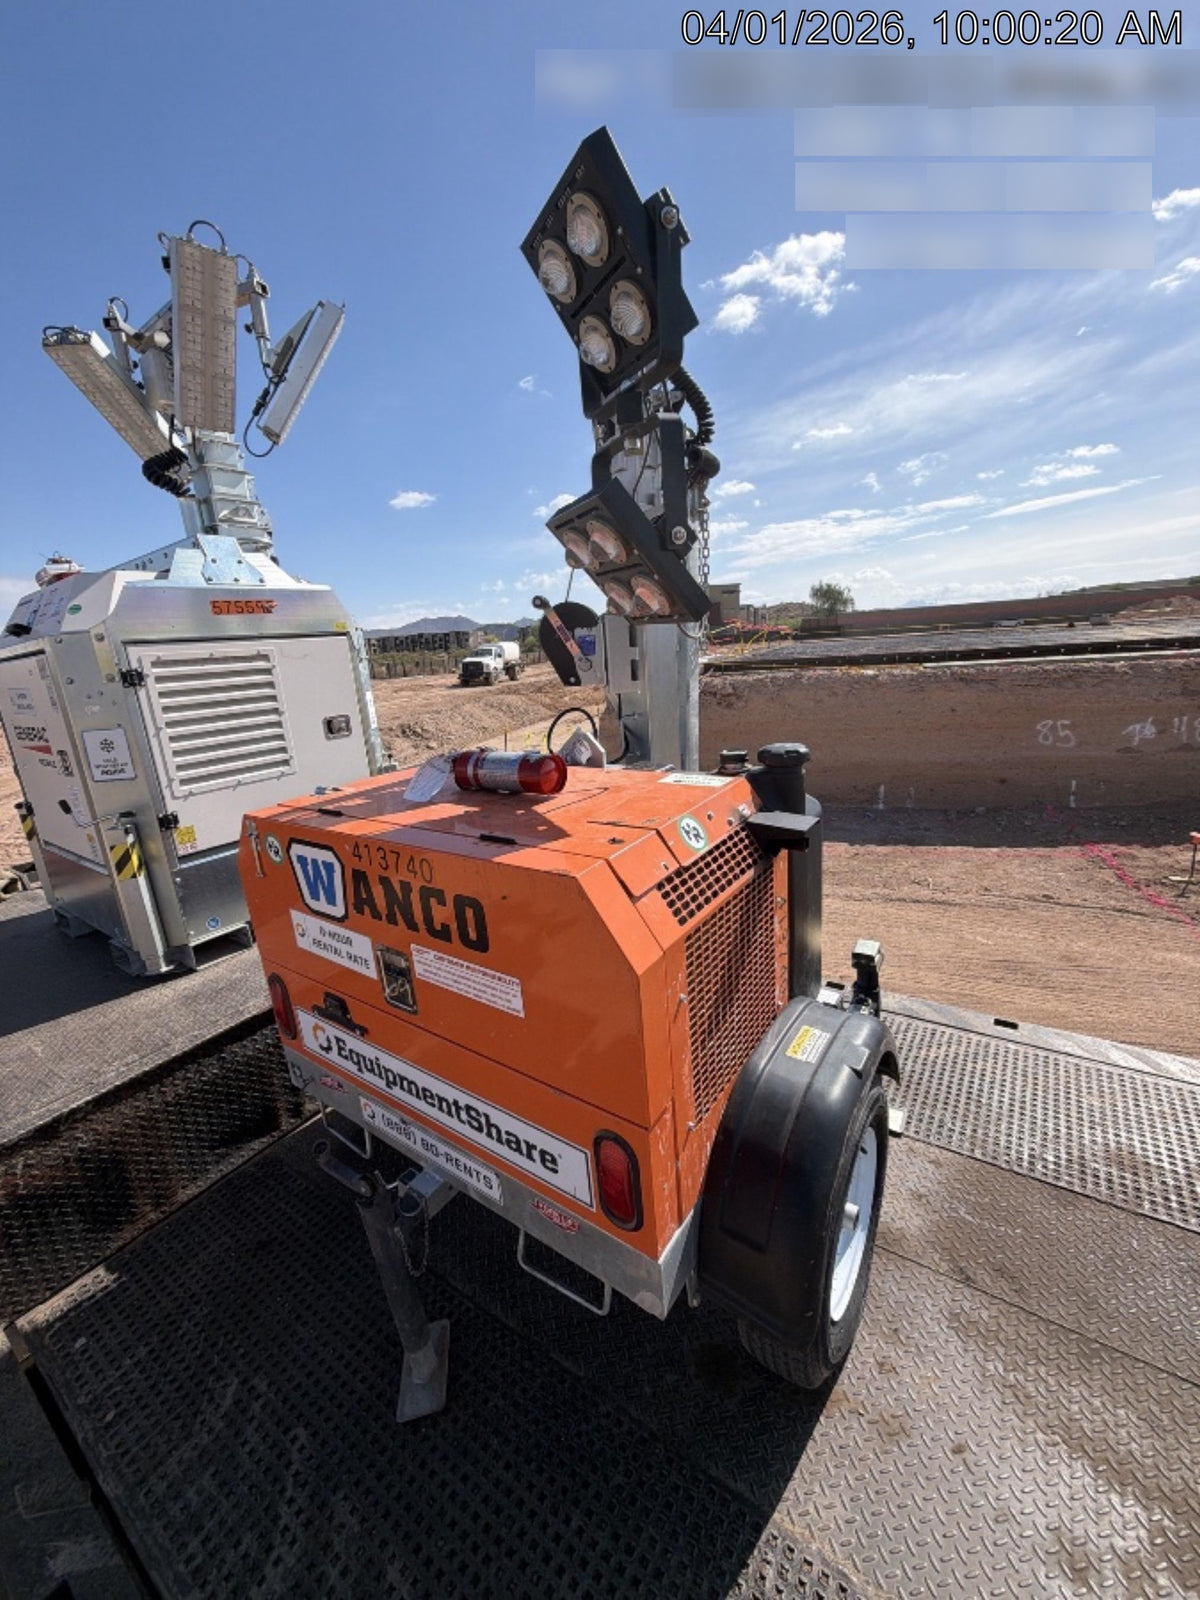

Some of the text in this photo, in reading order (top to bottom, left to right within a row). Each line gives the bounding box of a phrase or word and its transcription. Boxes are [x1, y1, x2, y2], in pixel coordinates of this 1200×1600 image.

[1036, 719, 1076, 748] 85
[352, 841, 434, 884] 413740
[295, 854, 490, 953] WANCO
[333, 1034, 560, 1175] EquipmentShare
